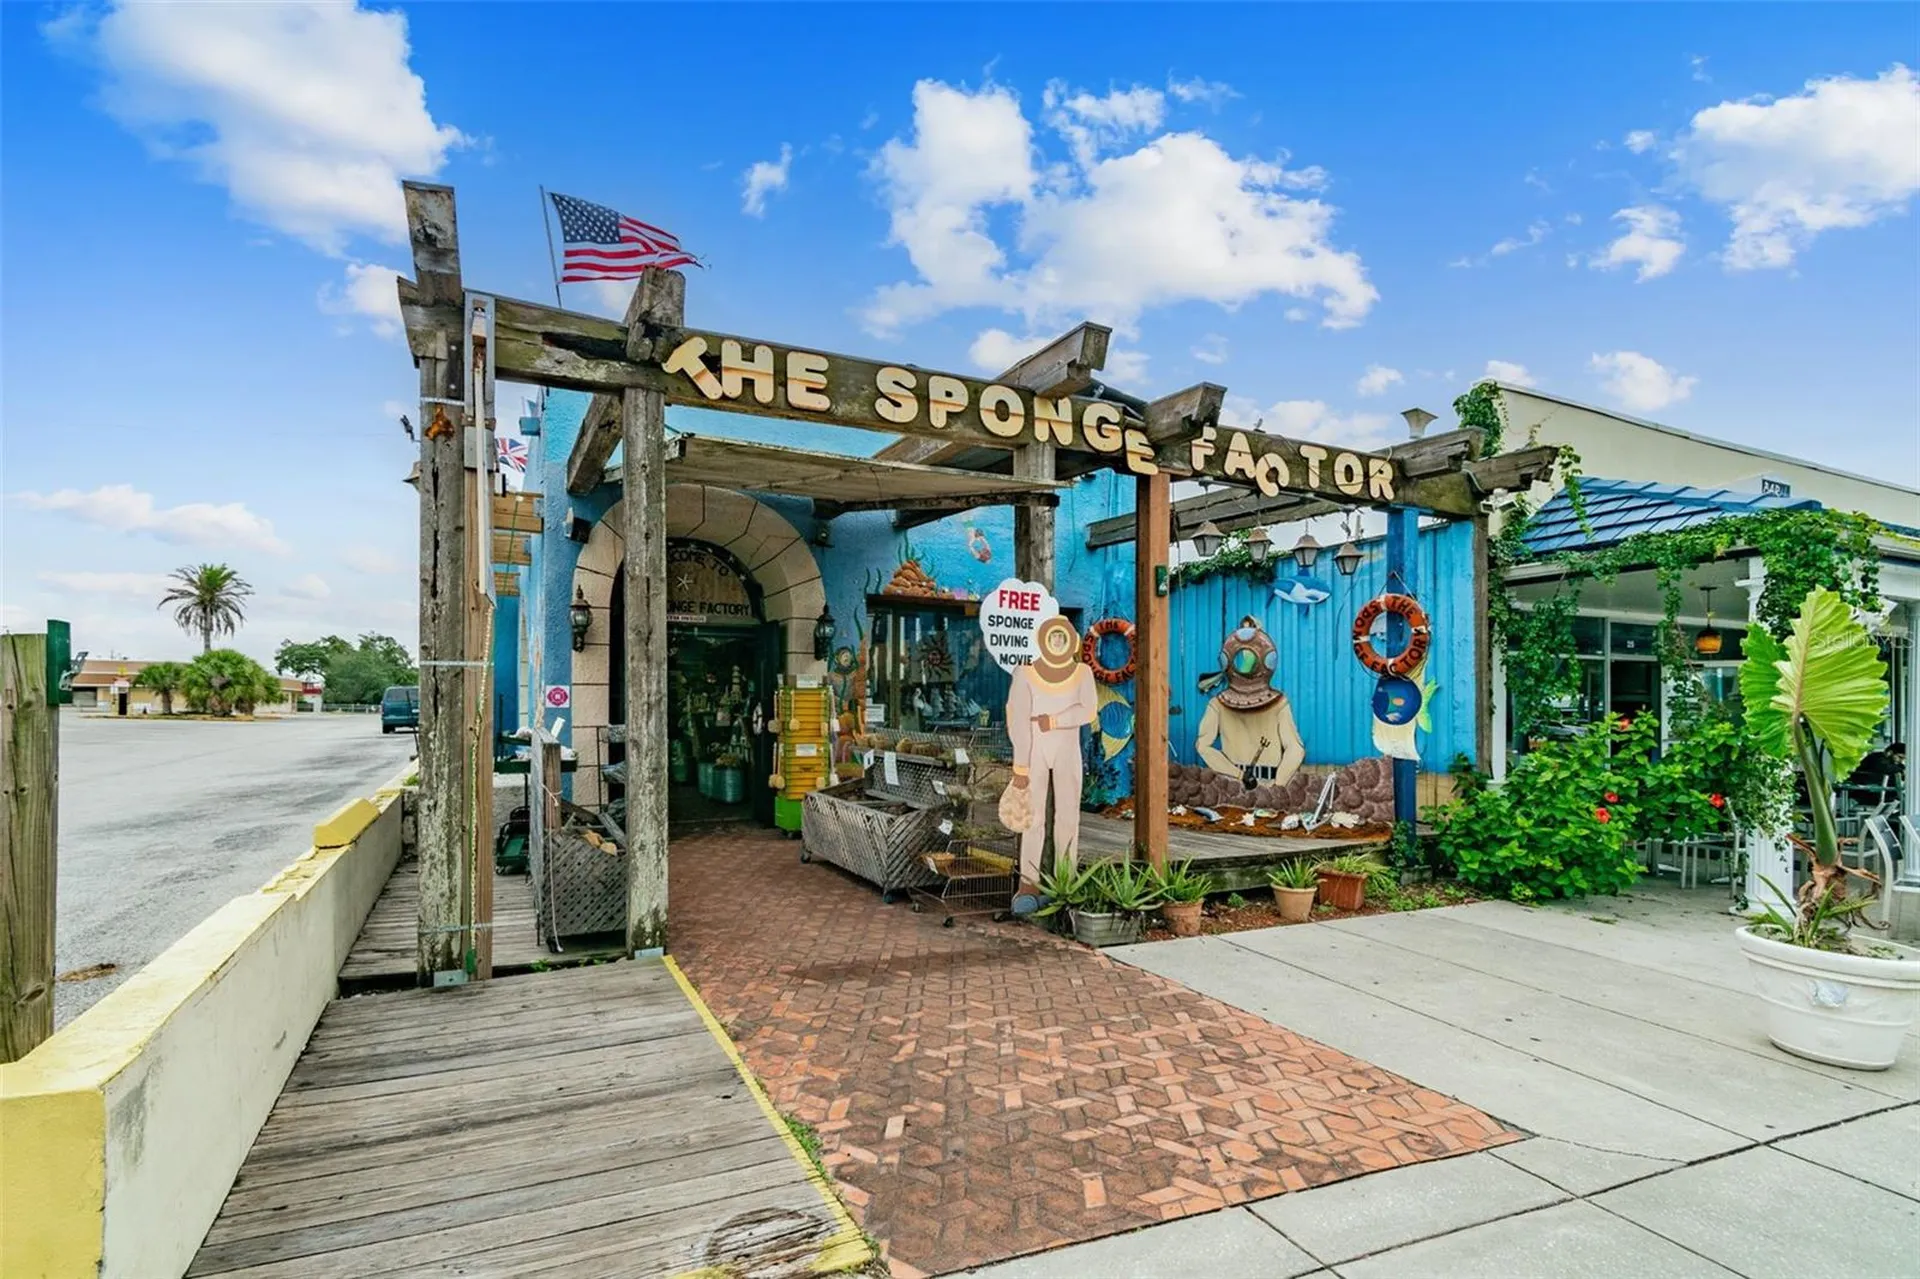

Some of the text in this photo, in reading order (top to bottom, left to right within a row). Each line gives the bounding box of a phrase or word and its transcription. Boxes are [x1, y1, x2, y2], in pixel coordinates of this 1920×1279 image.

[661, 335, 831, 412] THE
[874, 366, 1159, 475] SPONGE
[999, 589, 1041, 611] FREE
[1391, 595, 1416, 619] THE
[699, 601, 750, 616] FACTORY
[988, 614, 1034, 630] SPONGE
[990, 633, 1029, 648] DIVING
[1000, 653, 1034, 666] MOVIE
